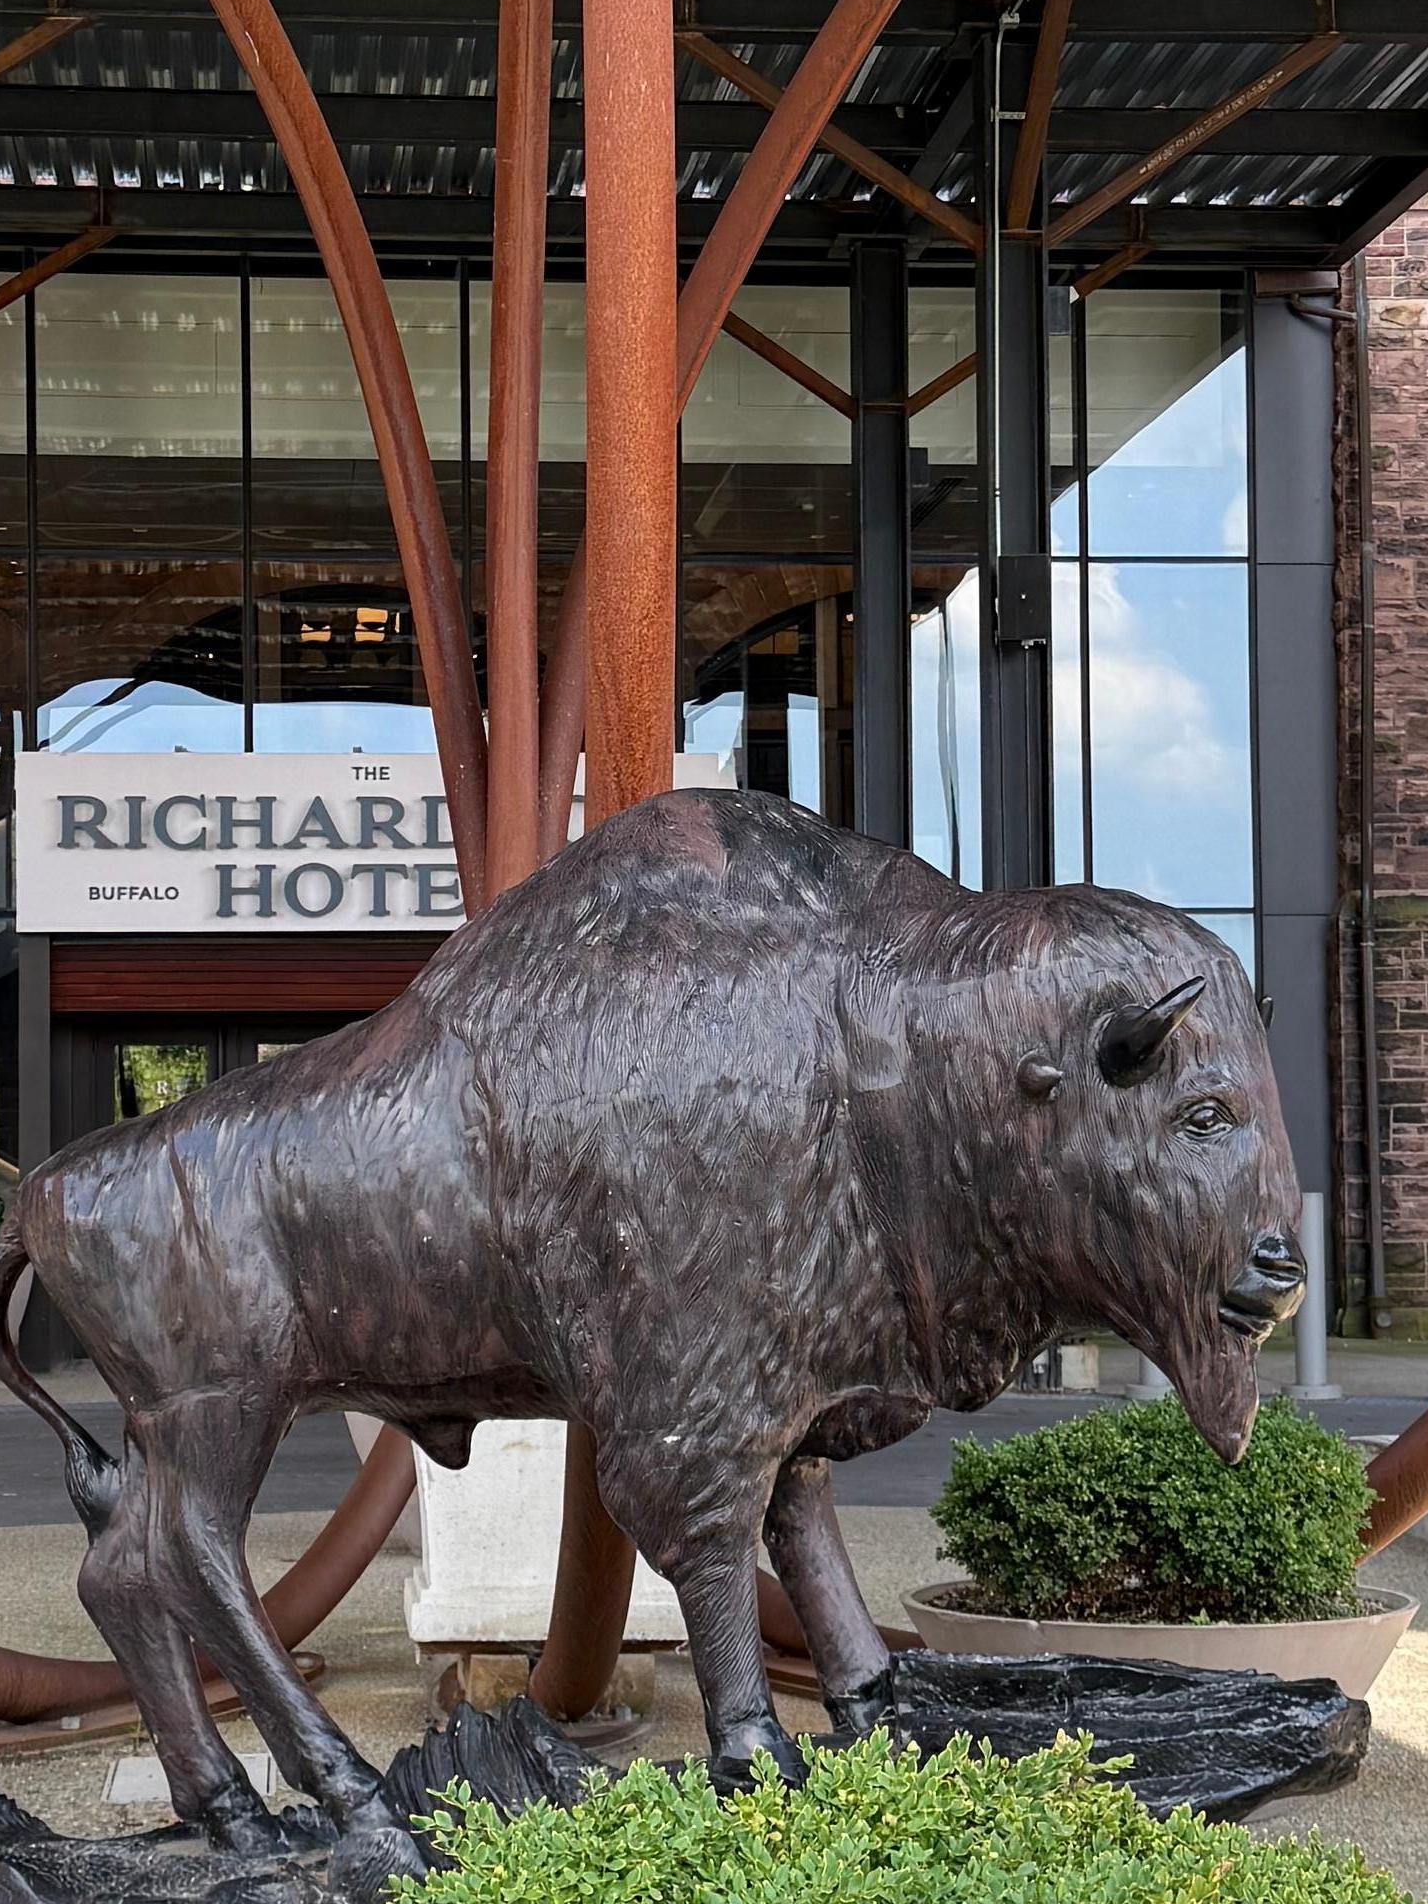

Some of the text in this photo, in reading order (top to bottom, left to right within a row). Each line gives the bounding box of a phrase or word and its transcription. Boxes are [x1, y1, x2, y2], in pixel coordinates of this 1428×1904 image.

[352, 766, 390, 781] THE
[57, 794, 584, 851] RICHARD
[88, 886, 179, 900] BUFFALO
[215, 862, 464, 917] HOTE
